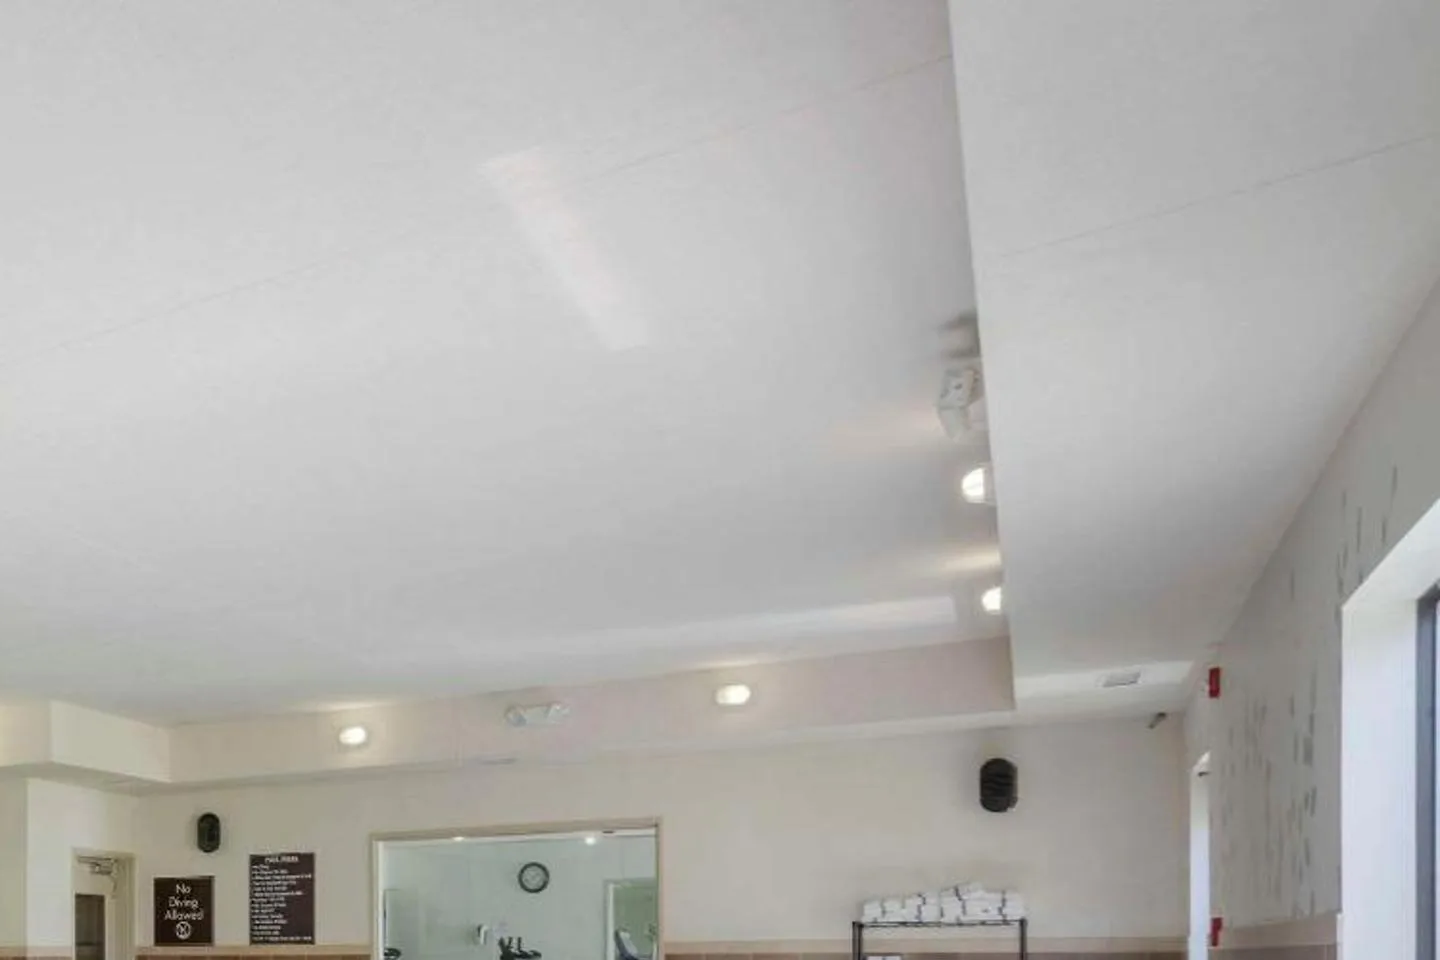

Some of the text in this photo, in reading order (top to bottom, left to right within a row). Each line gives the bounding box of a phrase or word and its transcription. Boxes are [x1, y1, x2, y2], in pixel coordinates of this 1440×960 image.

[176, 883, 191, 894] No
[169, 896, 199, 910] Diving
[164, 910, 204, 920] Allowed
